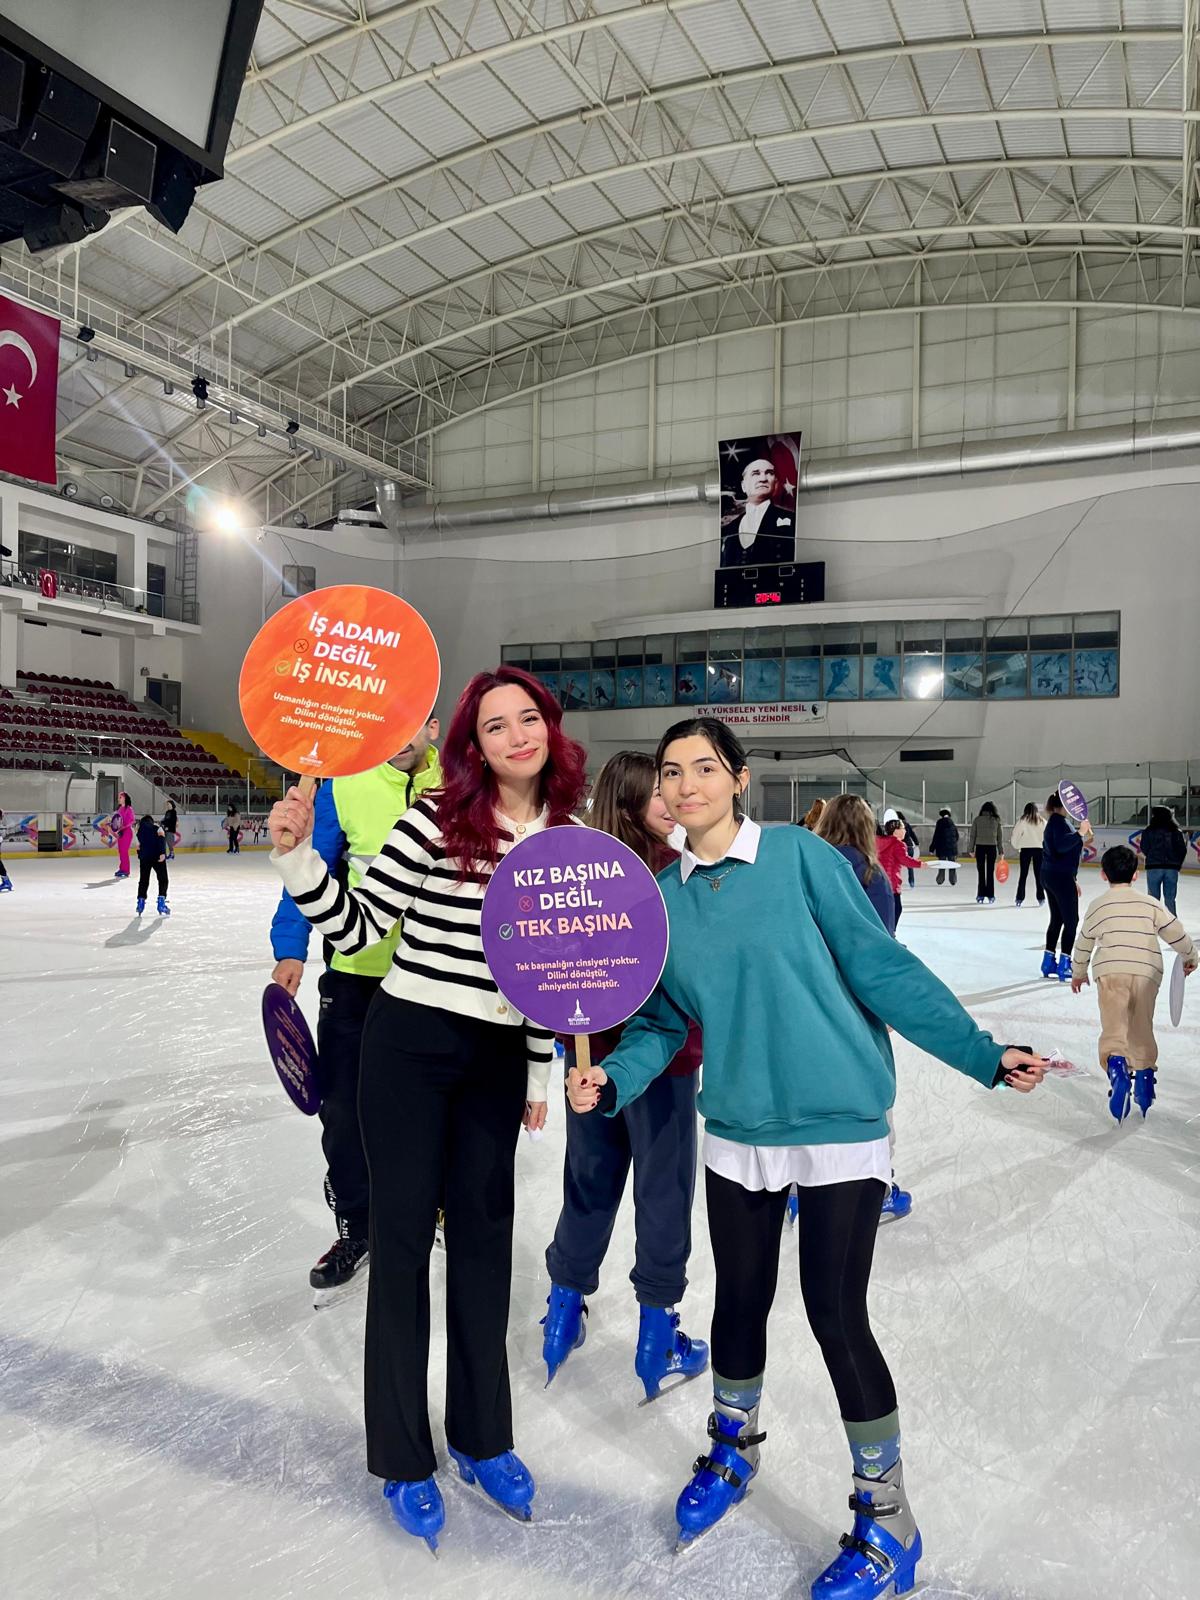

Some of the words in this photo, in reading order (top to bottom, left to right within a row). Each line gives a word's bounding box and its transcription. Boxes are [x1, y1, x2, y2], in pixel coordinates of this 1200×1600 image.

[308, 611, 329, 638] İŞ
[329, 621, 401, 648] ADAMI
[313, 642, 378, 671] DEĞİL,
[292, 658, 312, 683] İŞ
[314, 662, 387, 695] İNSANI
[273, 692, 320, 709] Uzmanlığın
[321, 700, 356, 716] cinsiyeti
[356, 707, 386, 722] yoktur.
[294, 707, 317, 719] Dilini
[317, 711, 358, 728] dönüştür,
[697, 707, 710, 715] EY,
[711, 706, 756, 714] YÜKSELEN
[758, 704, 779, 713] YENİ
[781, 703, 807, 712] NESİL
[712, 714, 751, 723] TİKBAL
[752, 714, 791, 722] SİZİNDİR
[280, 715, 324, 732] zihniyetini
[324, 723, 365, 740] dönüştür.
[513, 868, 546, 888] KIZ
[550, 860, 626, 886] BAŞINA
[539, 886, 603, 910] DEĞİL,
[515, 919, 554, 938] TEK
[557, 912, 633, 938] BAŞINA
[515, 962, 530, 971] Tek
[531, 960, 575, 972] başınalığın
[575, 957, 609, 969] cinsiyeti
[610, 956, 640, 968] yoktur.
[547, 970, 569, 980] Dilini
[570, 968, 609, 980] dönüştür,
[537, 982, 580, 993] zihniyetini
[581, 979, 620, 991] dönüştür.
